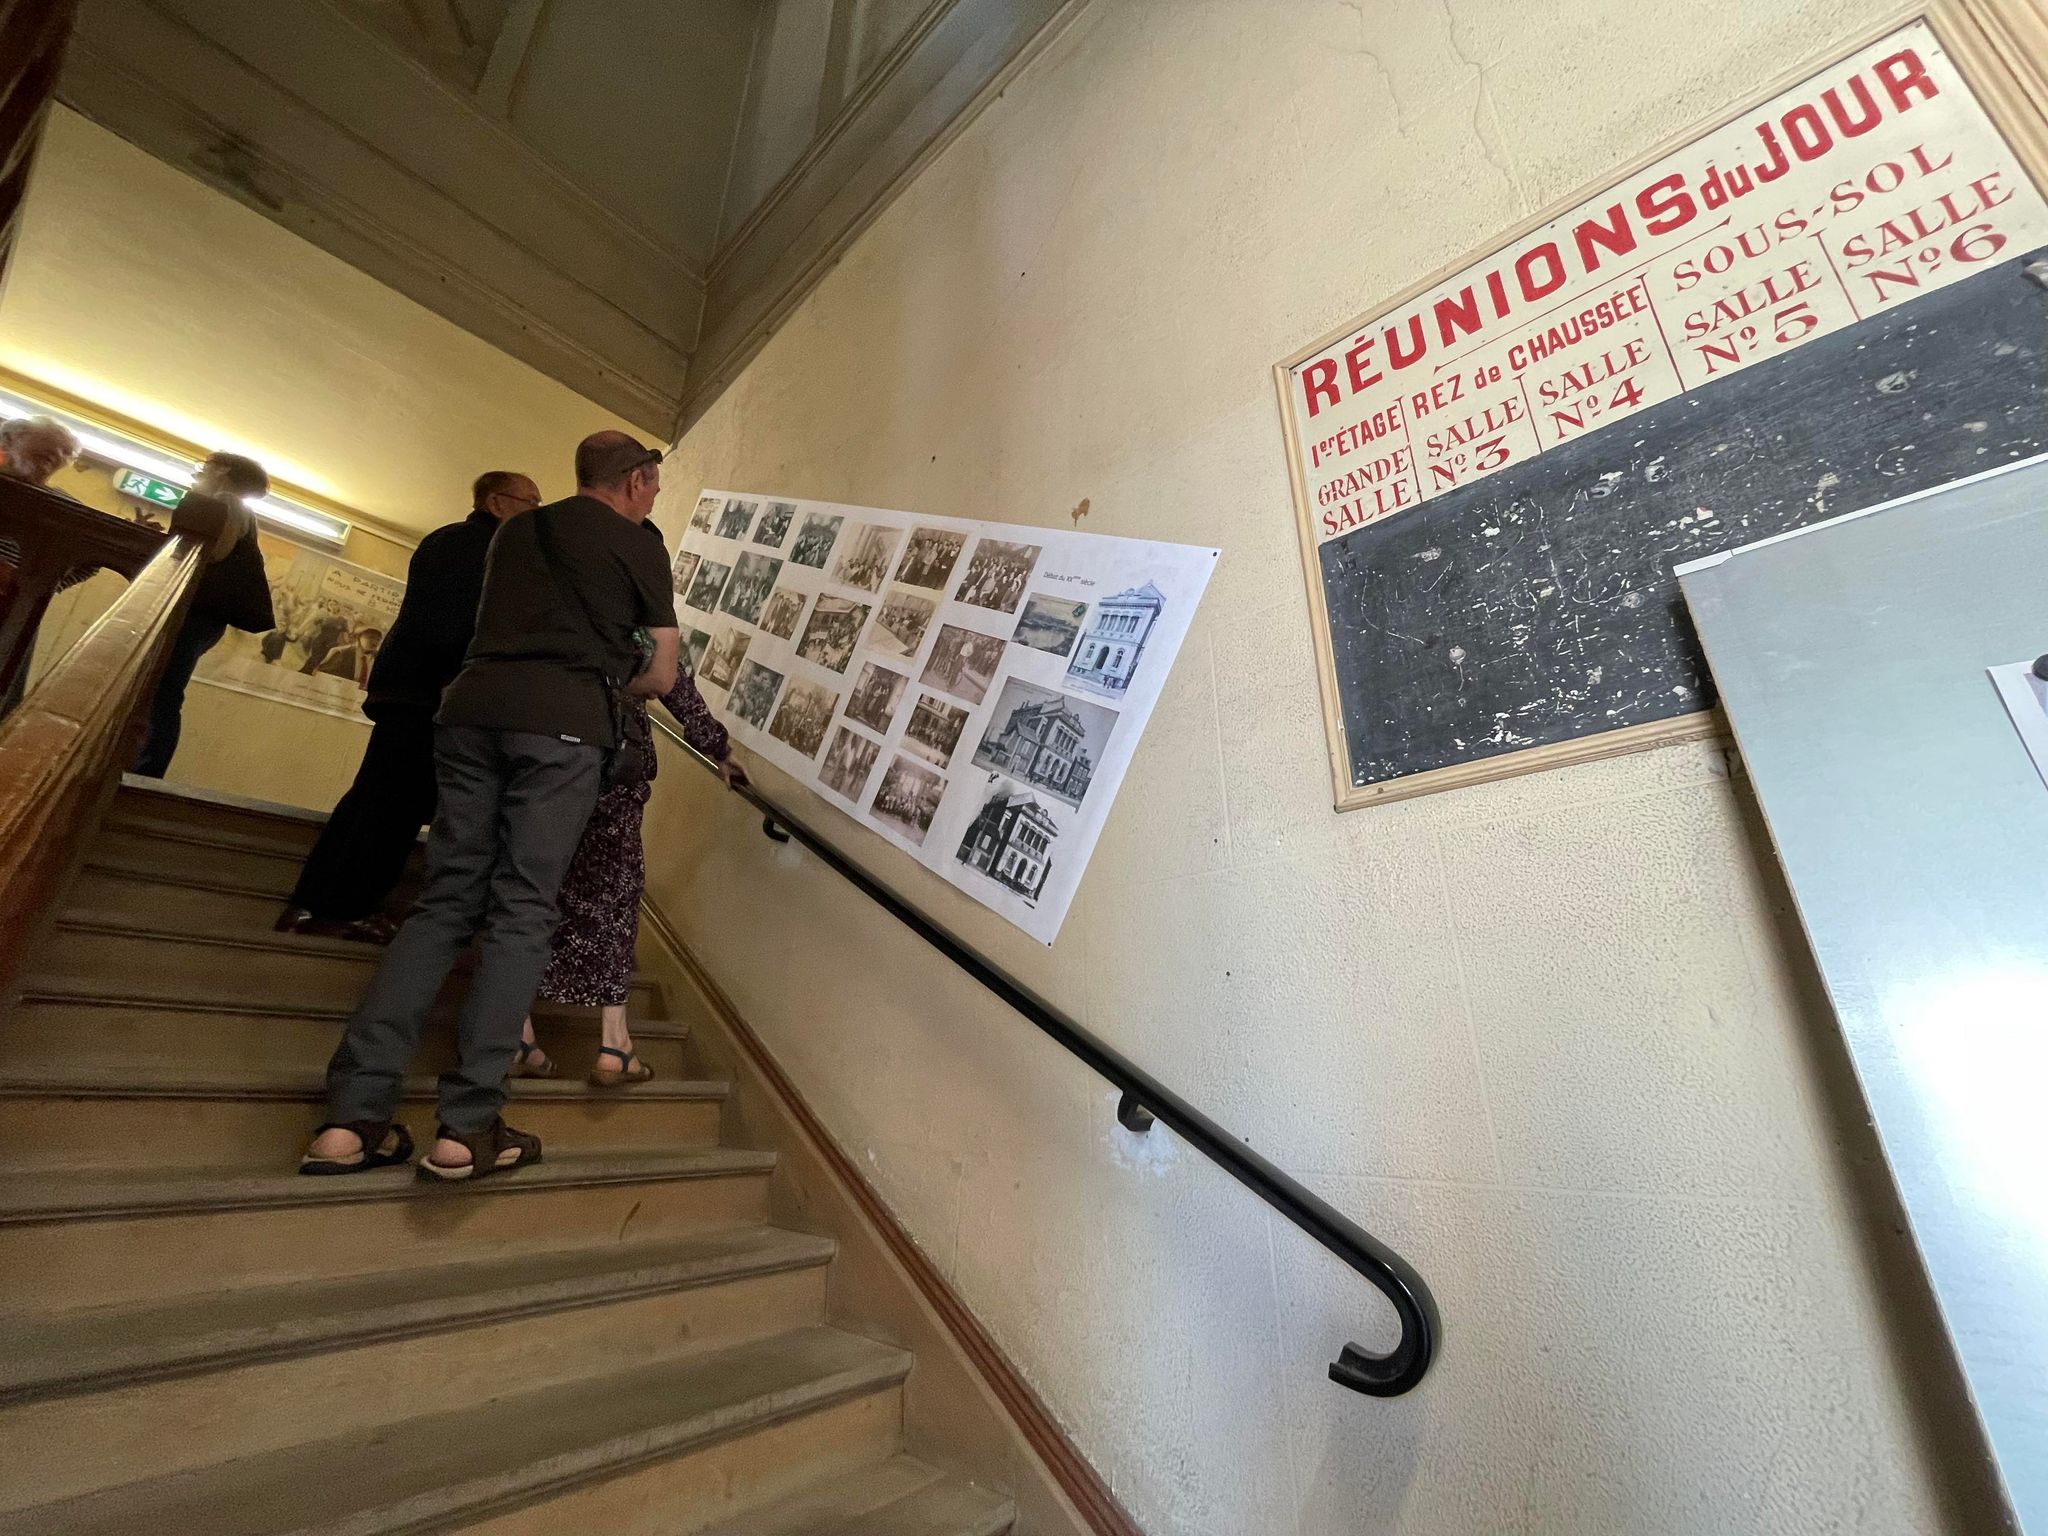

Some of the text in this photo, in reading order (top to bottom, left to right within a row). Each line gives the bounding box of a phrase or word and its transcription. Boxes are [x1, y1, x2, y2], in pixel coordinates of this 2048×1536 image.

[1300, 49, 1938, 418] RÉUNIONS du JOUR
[1673, 143, 1955, 293] SOUS-SOL
[1842, 171, 2017, 270] SALLE
[1949, 222, 2008, 264] 6
[1683, 260, 1823, 343] SALLE
[1773, 300, 1819, 345] 5
[1410, 284, 1649, 421] REZ de CHAUSSÉE
[1538, 337, 1652, 407] SALLE
[1607, 375, 1646, 410] 4
[1425, 395, 1526, 459] SALLE
[1474, 434, 1511, 472] 3
[1317, 442, 1411, 507] GRANDE
[1322, 478, 1412, 537] SALLE
